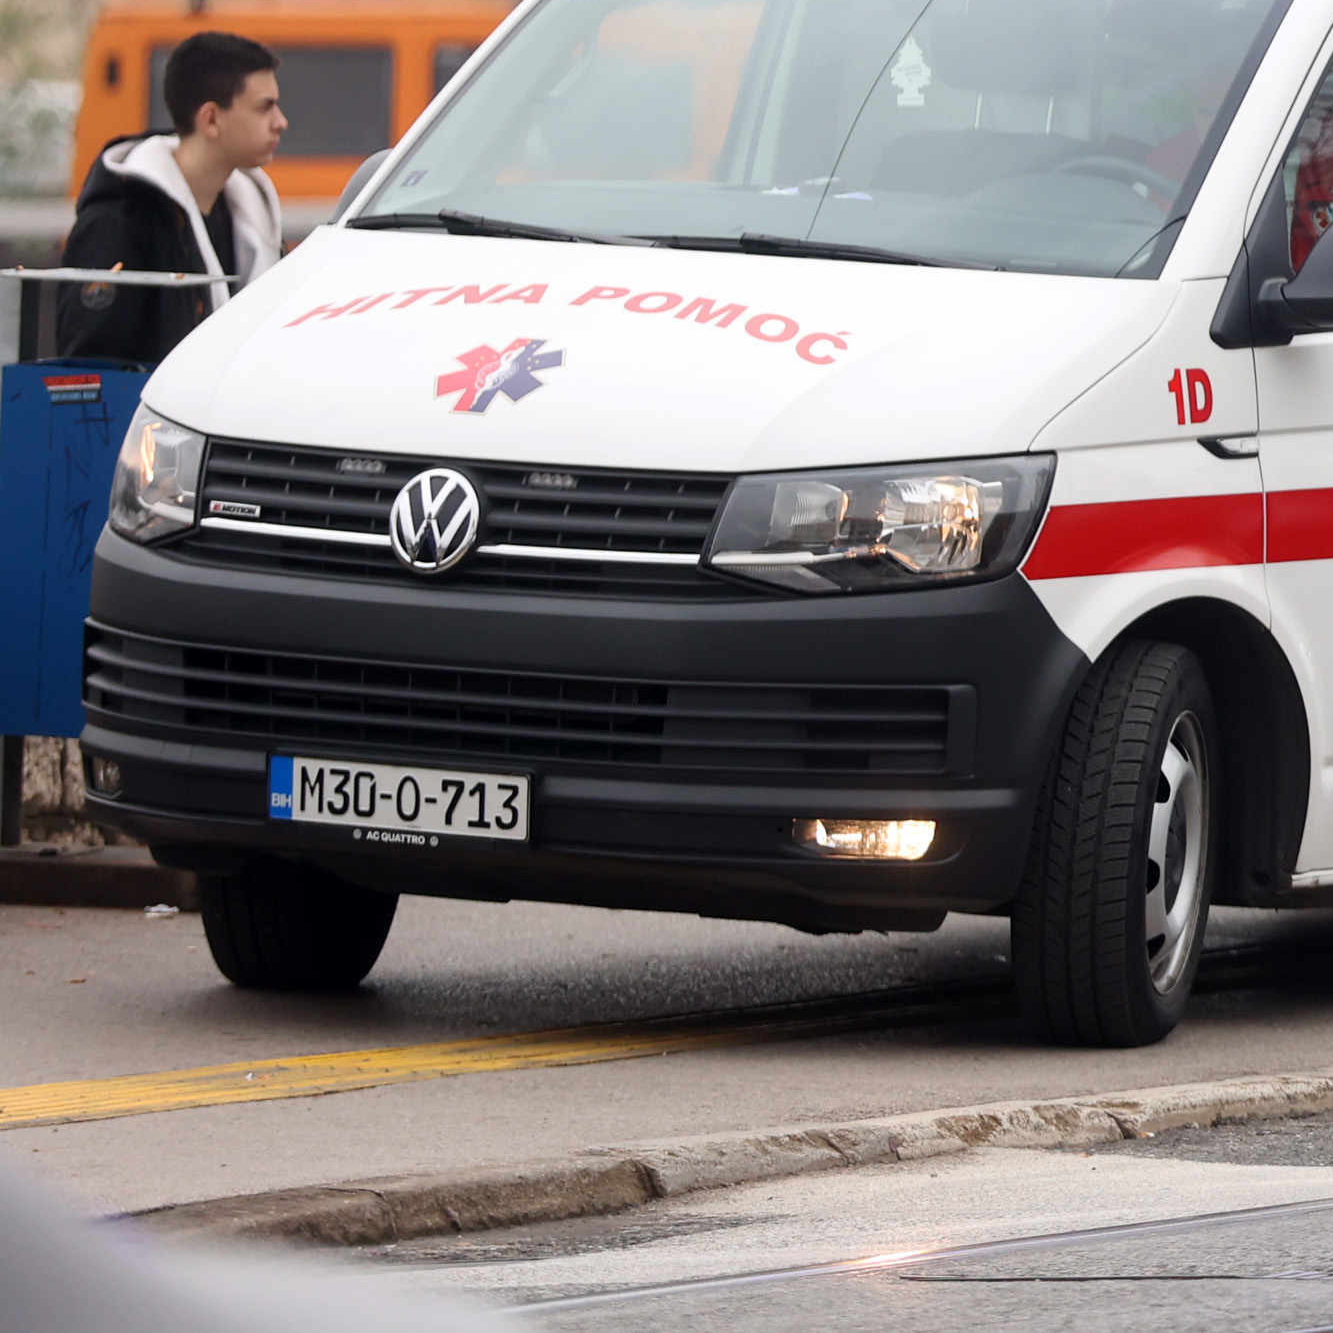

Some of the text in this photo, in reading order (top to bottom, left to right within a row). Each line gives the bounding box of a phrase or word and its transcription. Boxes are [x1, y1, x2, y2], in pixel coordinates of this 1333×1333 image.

[281, 283, 852, 365] HITNA POMOĆ
[1168, 367, 1213, 426] 1D
[270, 792, 292, 808] BIH
[366, 830, 426, 846] AC QUATTRO
